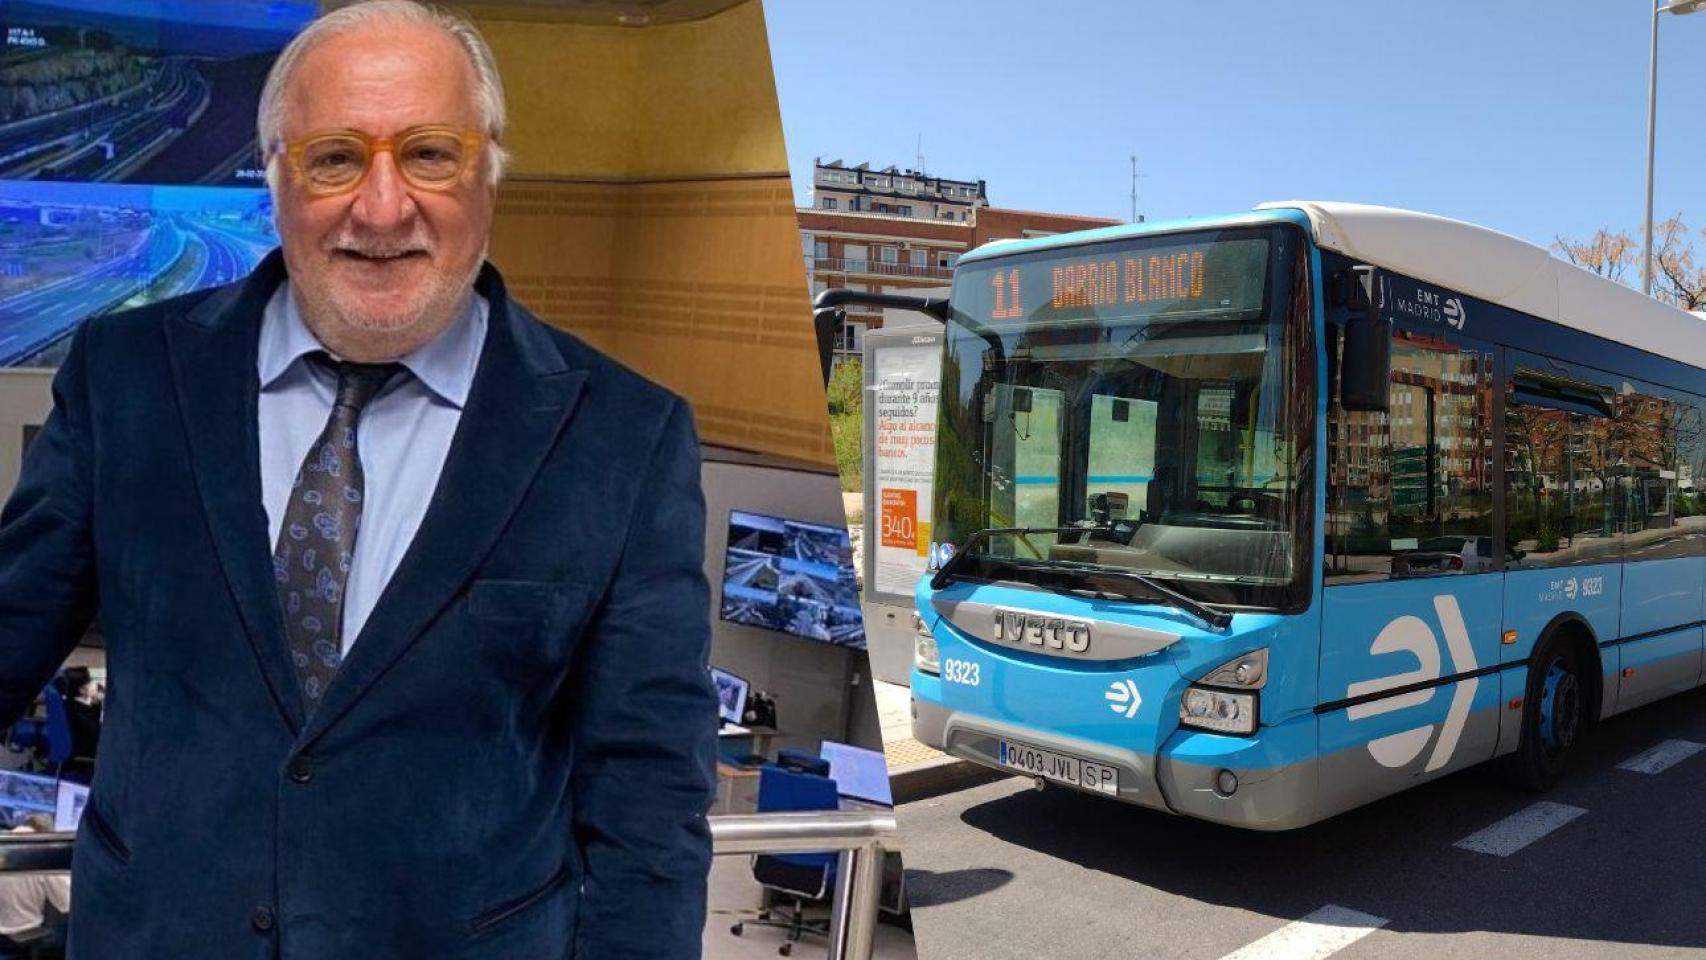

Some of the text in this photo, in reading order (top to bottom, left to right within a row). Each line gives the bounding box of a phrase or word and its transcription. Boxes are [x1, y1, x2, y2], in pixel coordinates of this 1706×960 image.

[992, 268, 1023, 318] 11
[1124, 252, 1204, 302] BLANCO
[1417, 288, 1440, 306] EMT
[1397, 298, 1441, 322] MADRID
[879, 393, 911, 404] durante
[912, 392, 918, 404] 9
[879, 405, 919, 420] seguidos?
[1582, 577, 1602, 597] 9323
[994, 611, 1090, 652] IVECO
[945, 658, 980, 686] 9323
[1008, 745, 1044, 772] 0403
[1048, 757, 1076, 781] JVL
